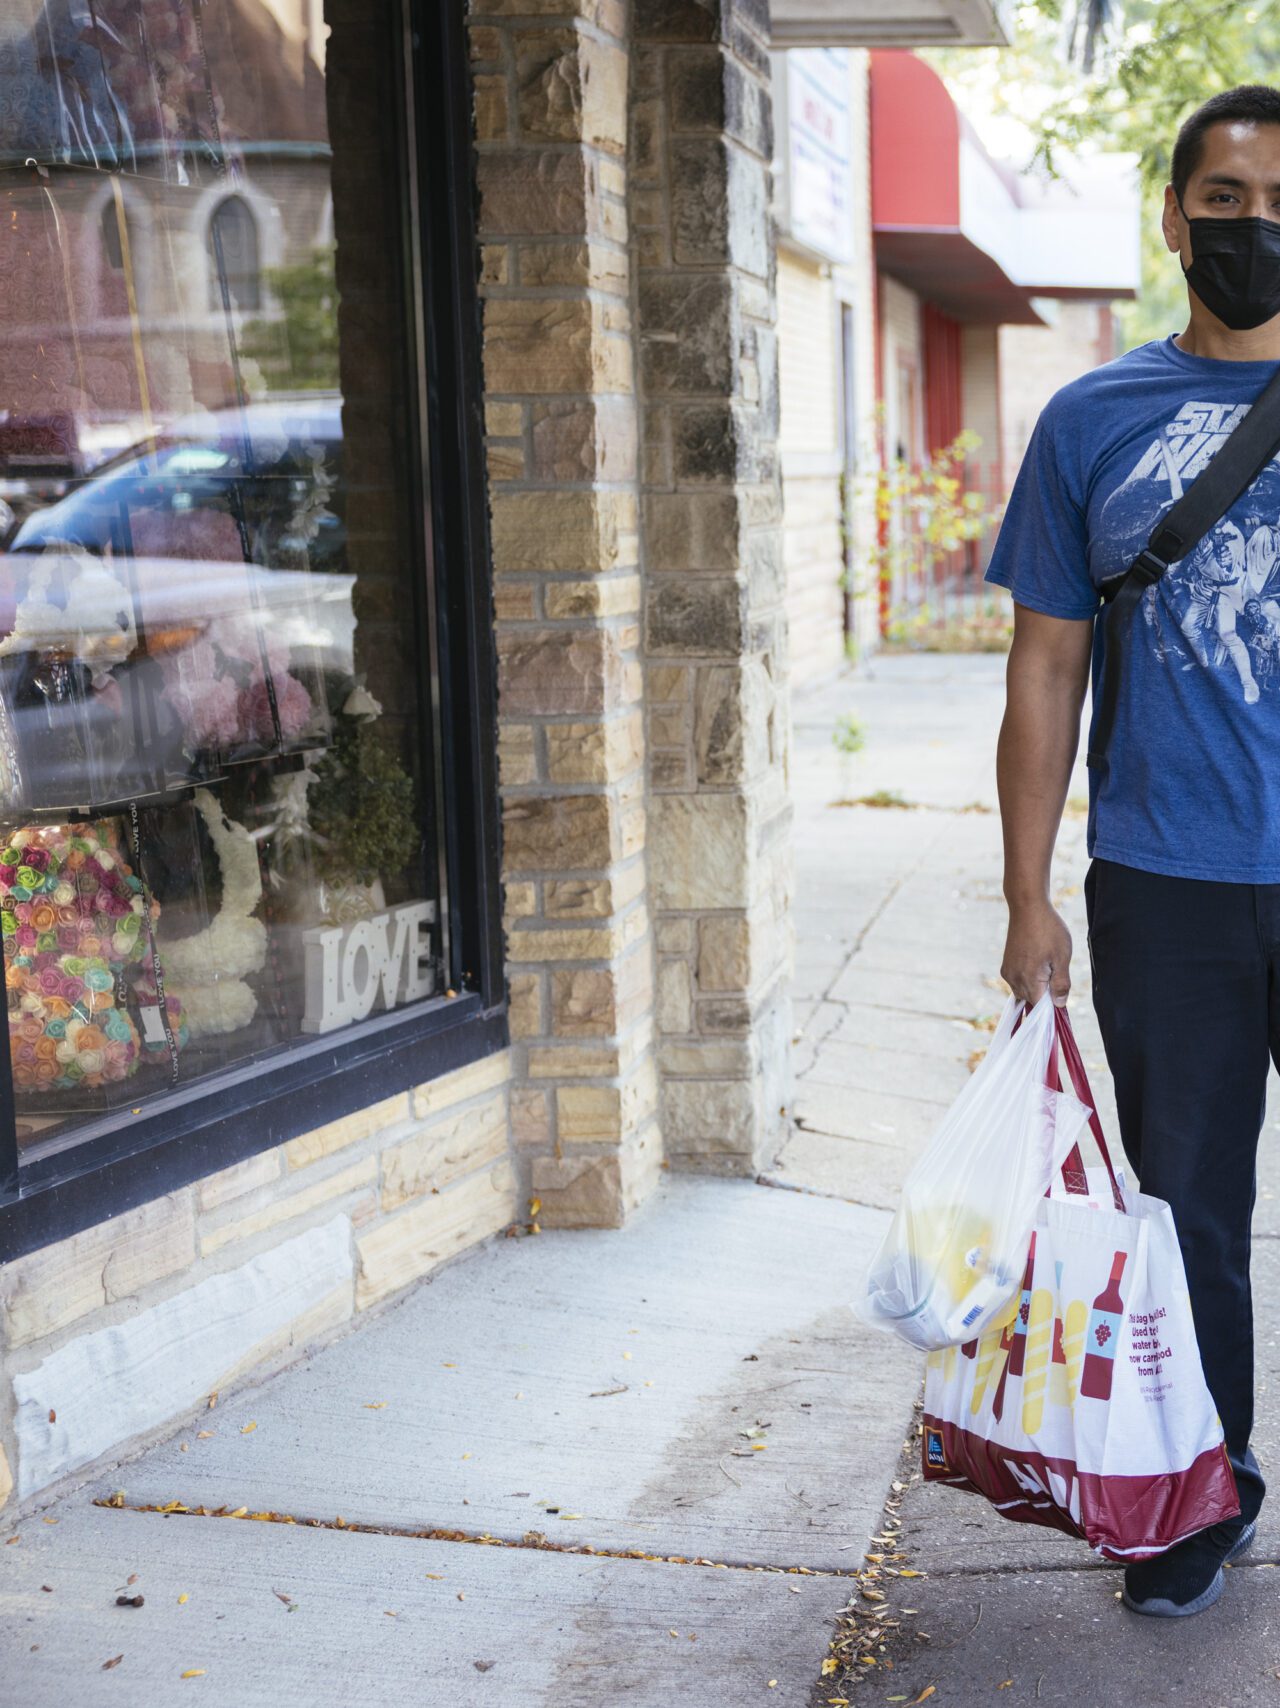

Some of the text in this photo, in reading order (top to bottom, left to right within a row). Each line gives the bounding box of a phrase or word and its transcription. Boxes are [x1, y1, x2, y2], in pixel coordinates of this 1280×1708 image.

[129, 802, 138, 825] YOU
[153, 954, 161, 976] YOU
[318, 899, 436, 1034] LOVE
[156, 976, 165, 1003] LOVE
[166, 1028, 174, 1049] YOU
[171, 1050, 179, 1077] LOVE
[1136, 1313, 1148, 1325] bag
[1132, 1327, 1148, 1337] Used
[1132, 1341, 1151, 1350] water
[1129, 1355, 1141, 1363] now
[1138, 1366, 1153, 1377] from
